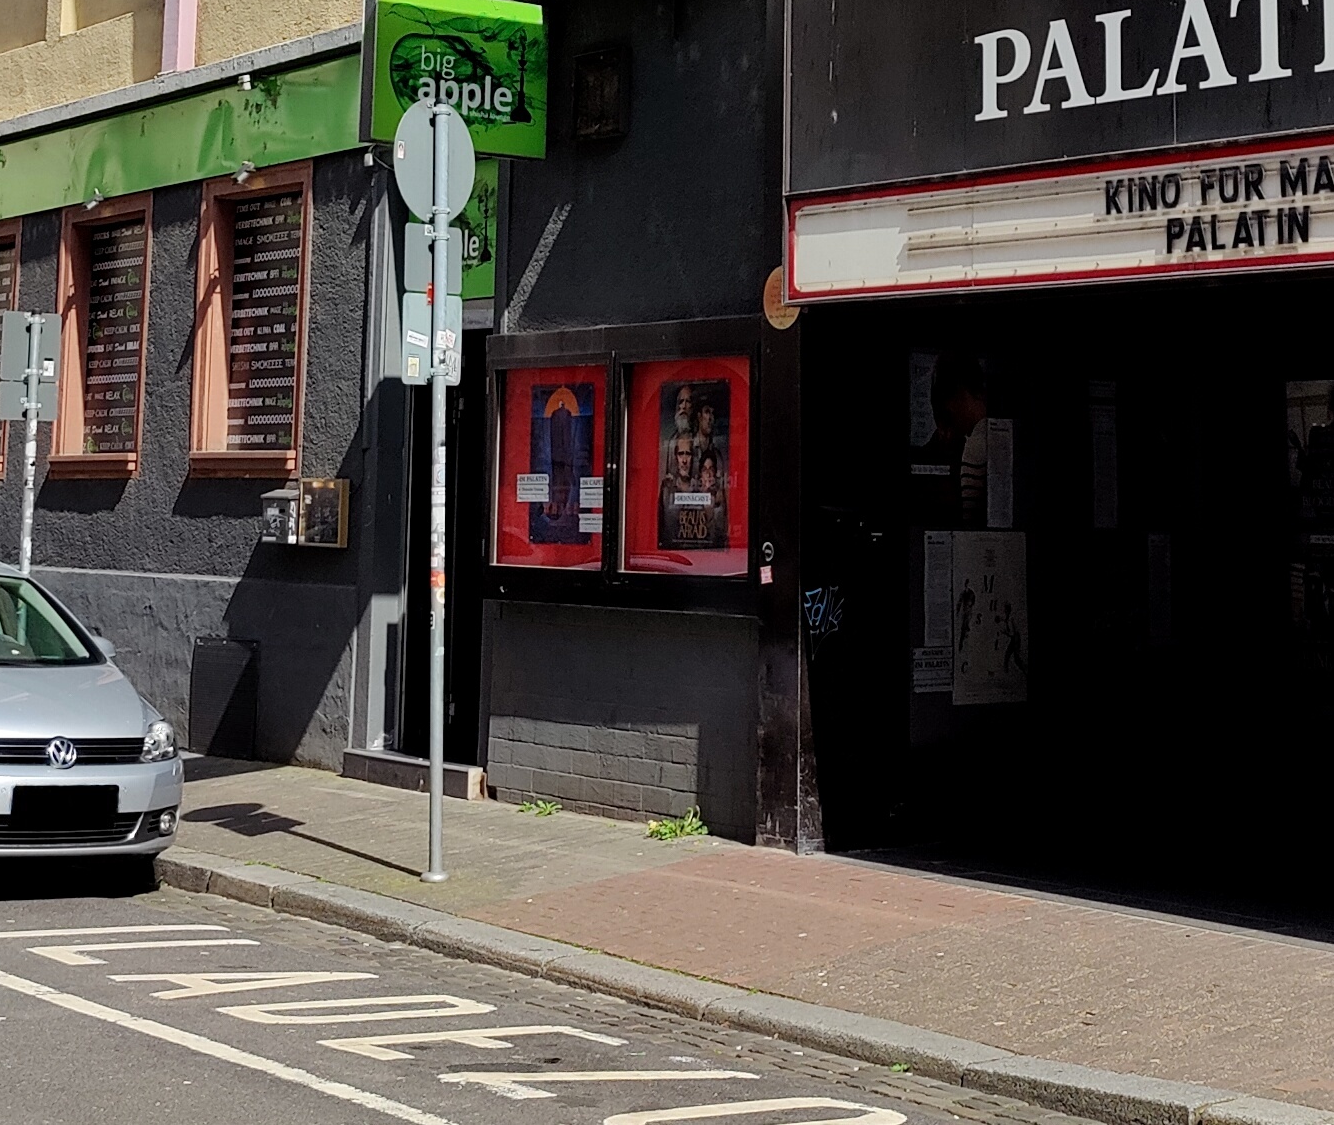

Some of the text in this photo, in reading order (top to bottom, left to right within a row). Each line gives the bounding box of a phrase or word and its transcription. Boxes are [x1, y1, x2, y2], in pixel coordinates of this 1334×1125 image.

[419, 44, 456, 80] big
[417, 75, 513, 116] apple
[1104, 172, 1182, 216] KINO
[1165, 205, 1312, 255] PALATIN
[678, 523, 708, 539] AFRAID
